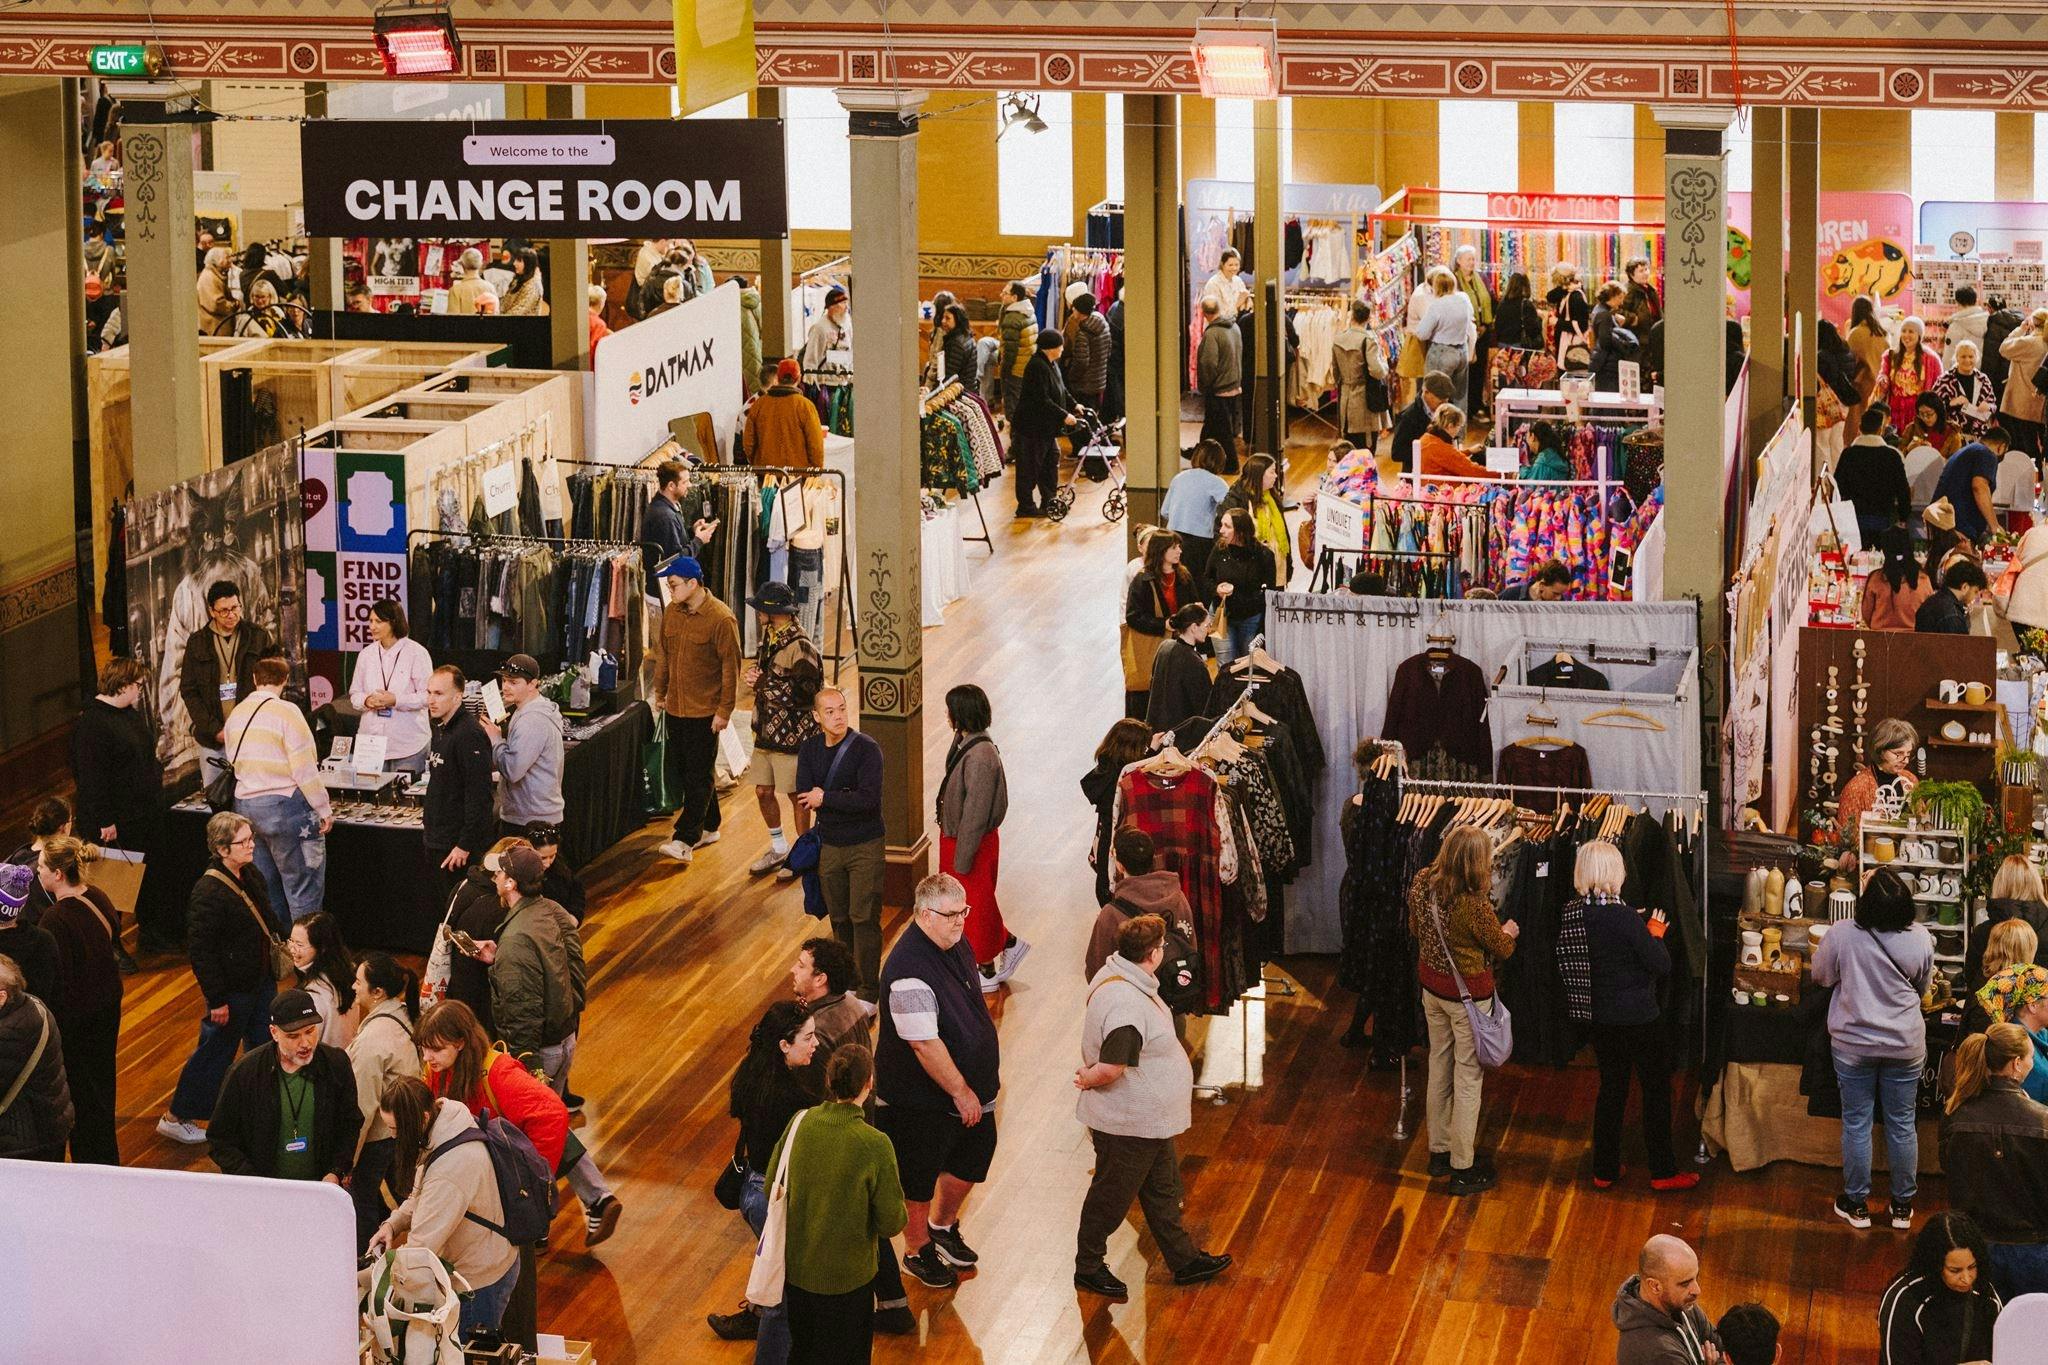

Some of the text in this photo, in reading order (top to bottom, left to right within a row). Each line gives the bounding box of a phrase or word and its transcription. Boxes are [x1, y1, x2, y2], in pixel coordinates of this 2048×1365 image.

[96, 51, 128, 70] EXIT
[489, 146, 589, 157] Welcome to the
[345, 179, 742, 221] CHANGE ROOM
[645, 337, 714, 398] DATWAX
[343, 560, 402, 581] FIND
[344, 583, 402, 602] SEEK
[1278, 610, 1416, 629] HARPER & EDIE
